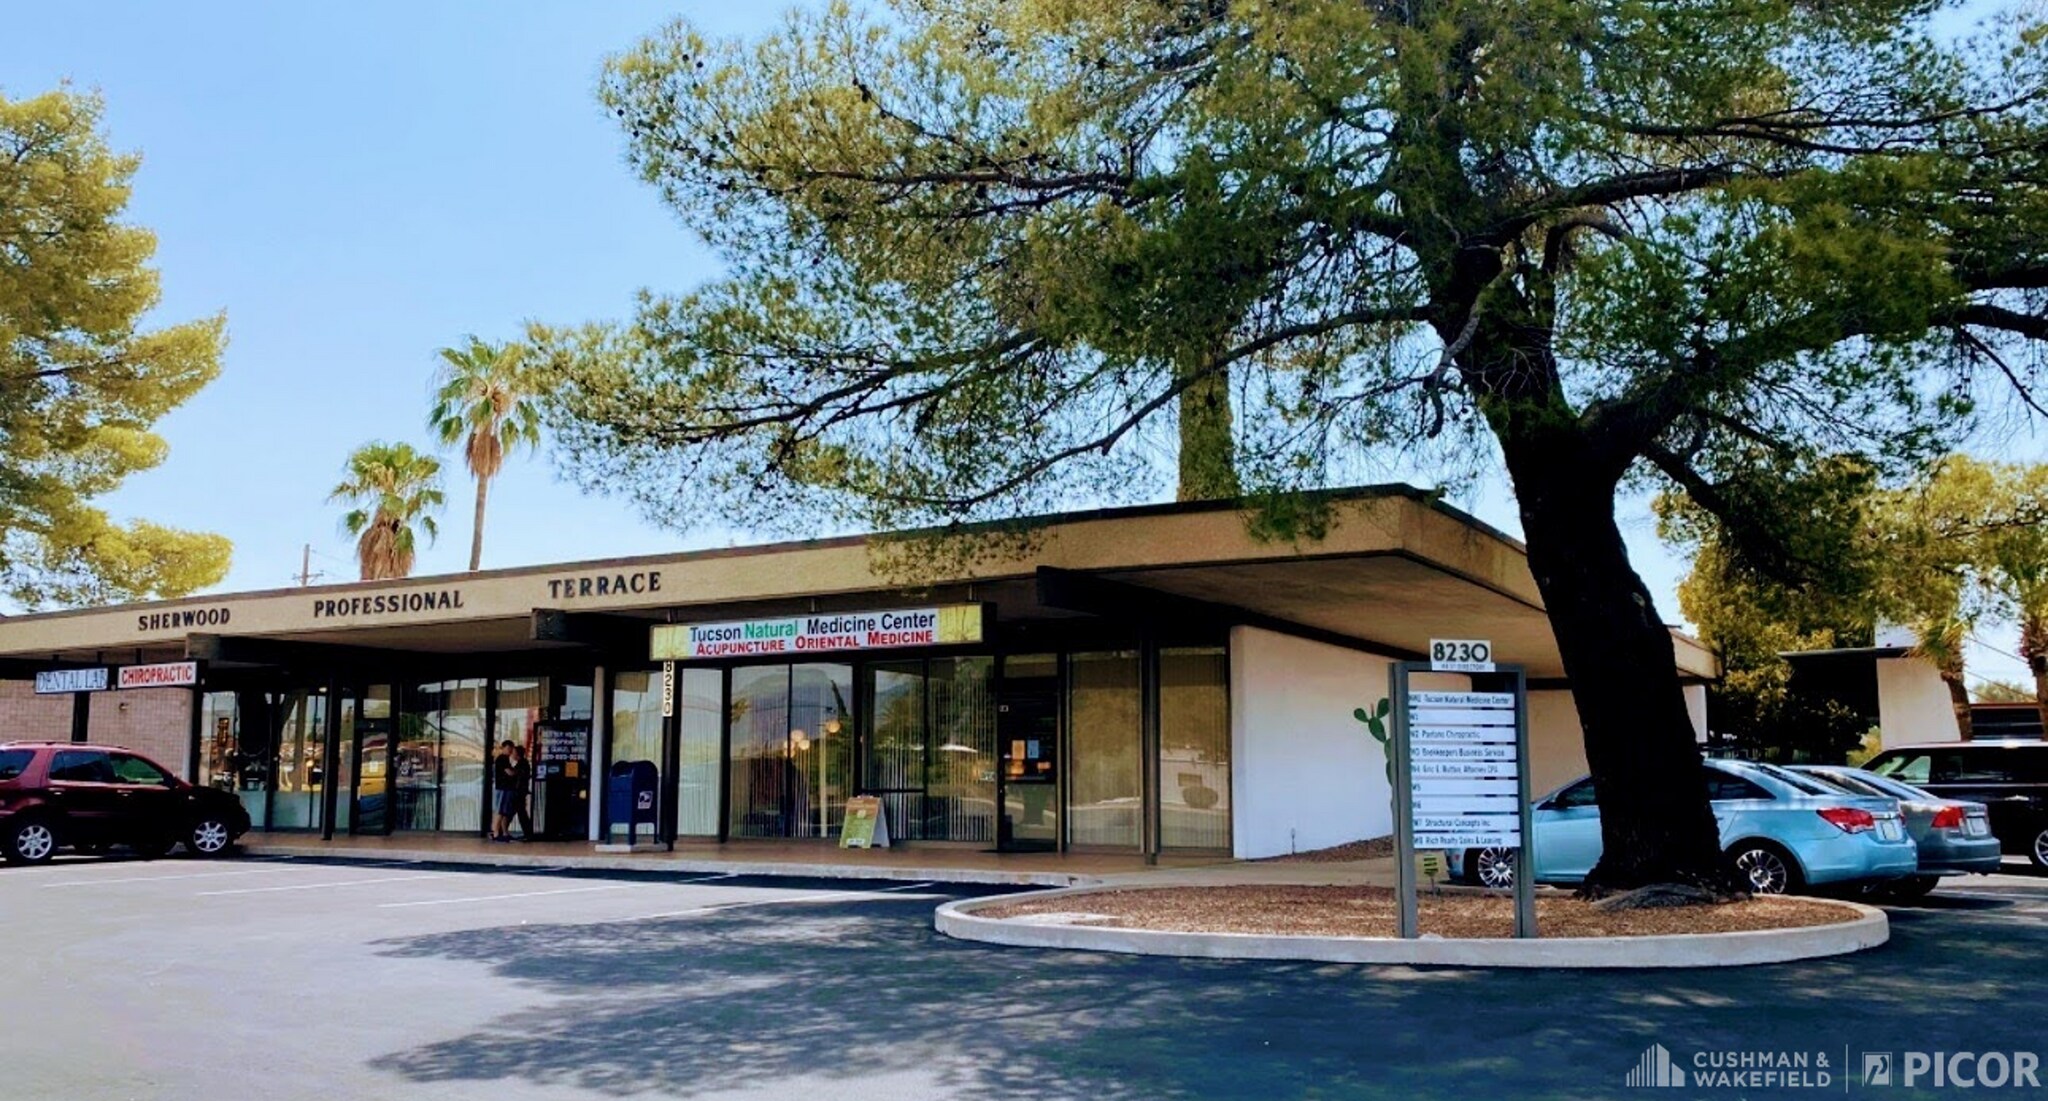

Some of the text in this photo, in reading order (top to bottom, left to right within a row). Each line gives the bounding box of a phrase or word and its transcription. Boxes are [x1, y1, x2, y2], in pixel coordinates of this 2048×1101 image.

[138, 572, 661, 631] SHERWOOD PROFESSIONAL TERRACE
[690, 612, 936, 642] Tucson Natural Medicine Center
[696, 630, 933, 655] ACUPUNCTURE ORIENTAL MEDICINE
[1433, 642, 1489, 662] 8230
[38, 669, 108, 691] DENTAL LAB
[121, 665, 193, 685] CHIROPRACTIC
[664, 661, 673, 715] 8230
